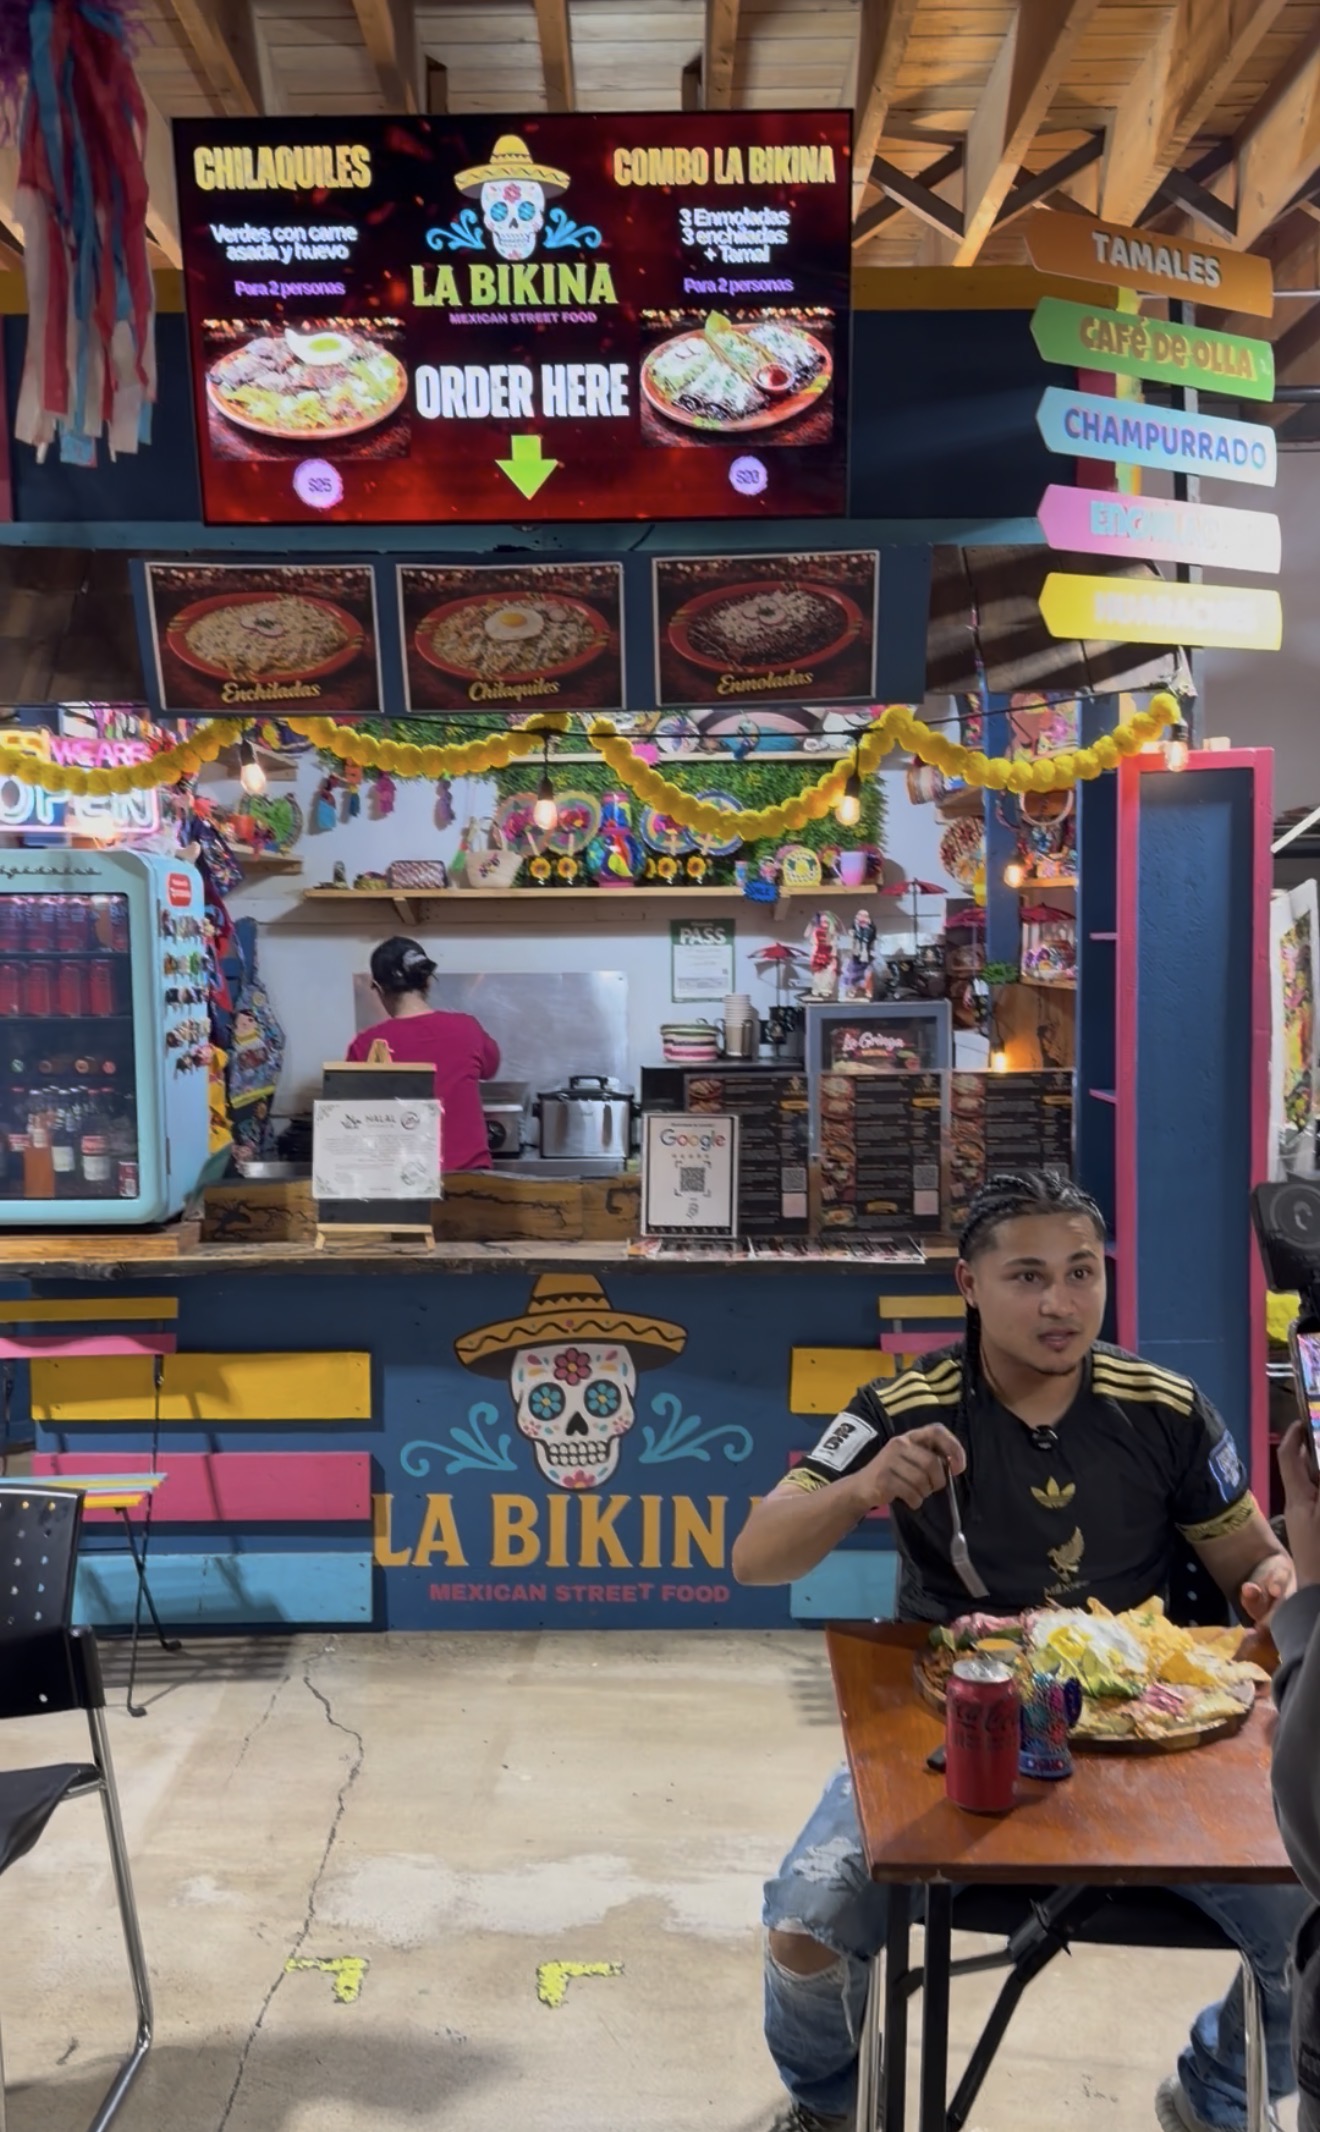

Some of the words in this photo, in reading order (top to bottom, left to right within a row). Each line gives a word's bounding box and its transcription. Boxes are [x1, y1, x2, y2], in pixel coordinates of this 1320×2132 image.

[193, 145, 372, 190] CHILAQUILES
[613, 147, 709, 186] COMBO
[714, 147, 745, 185] LA
[748, 145, 837, 184] BIKINA
[679, 208, 692, 227] 3
[693, 206, 790, 226] Enmoladas
[209, 223, 272, 243] Verdes
[272, 226, 307, 242] con
[681, 227, 695, 245] 3
[695, 225, 788, 245] enchiladas
[226, 241, 281, 261] asada
[279, 244, 293, 265] y
[294, 243, 351, 260] huevo
[718, 244, 771, 263] Tamal
[1092, 231, 1221, 288] TAMALES
[234, 281, 268, 296] Para
[268, 281, 281, 295] 2
[280, 282, 346, 299] personas
[411, 264, 462, 306] LA
[468, 262, 619, 305] BIKINA
[683, 277, 716, 293] Para
[717, 277, 729, 292] 2
[728, 278, 794, 296] personas
[449, 312, 509, 325] MEXICAN
[510, 312, 560, 323] STREET
[561, 311, 598, 323] FOOD
[414, 364, 536, 419] ORDER
[540, 363, 630, 417] HERE
[1063, 406, 1267, 470] CHAMPURRADO
[221, 680, 321, 704] Enchiladas
[468, 677, 560, 702] Chilaquiles
[717, 668, 814, 695] Enmoladas
[96, 740, 149, 768] ARE
[680, 927, 727, 946] PASS
[660, 1128, 727, 1152] Google
[371, 1493, 469, 1568] LA
[490, 1494, 769, 1569] BIKIN
[429, 1583, 547, 1602] MEXICAN
[554, 1582, 655, 1602] STREET
[661, 1584, 731, 1603] FOOD
